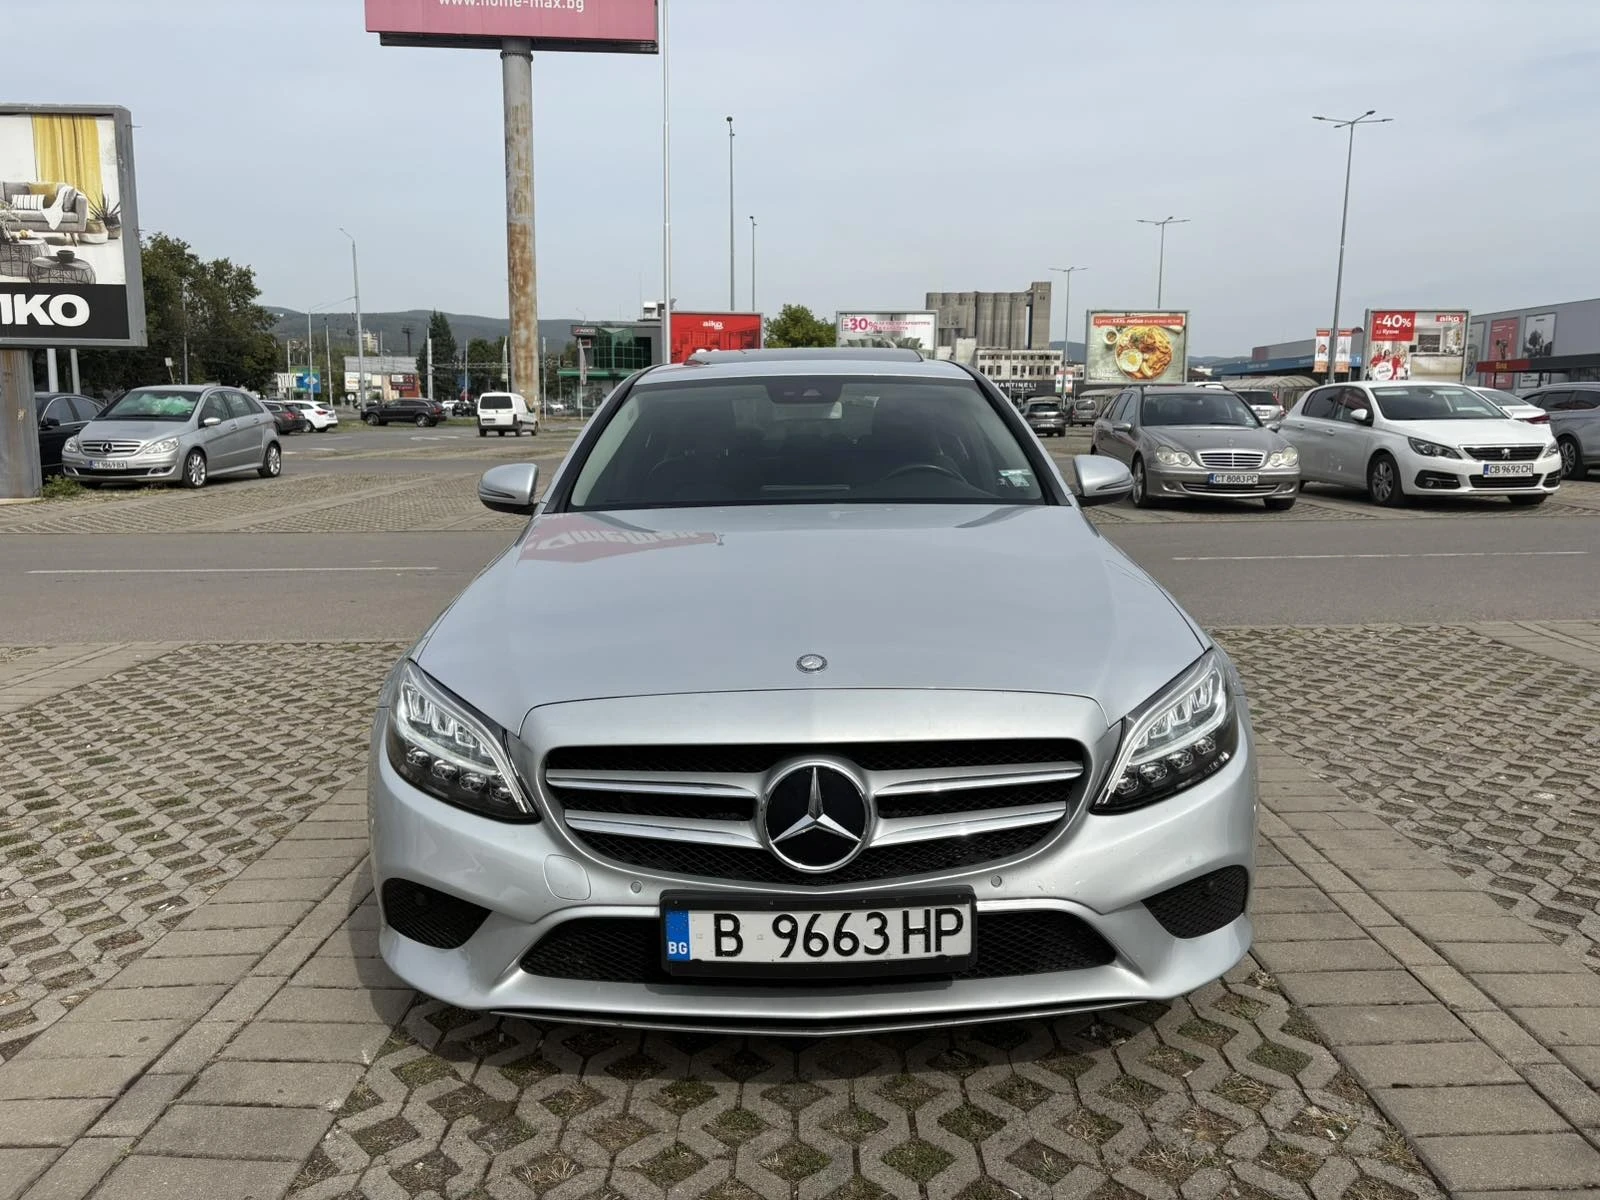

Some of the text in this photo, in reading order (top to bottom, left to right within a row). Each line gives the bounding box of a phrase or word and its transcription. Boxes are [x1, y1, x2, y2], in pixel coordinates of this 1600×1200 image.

[1439, 315, 1460, 323] aiko
[1489, 465, 1532, 474] CB 9692 CH
[1214, 475, 1226, 484] CT
[1246, 475, 1258, 484] PC
[713, 907, 963, 958] B 9663 HP
[668, 942, 688, 955] BG
